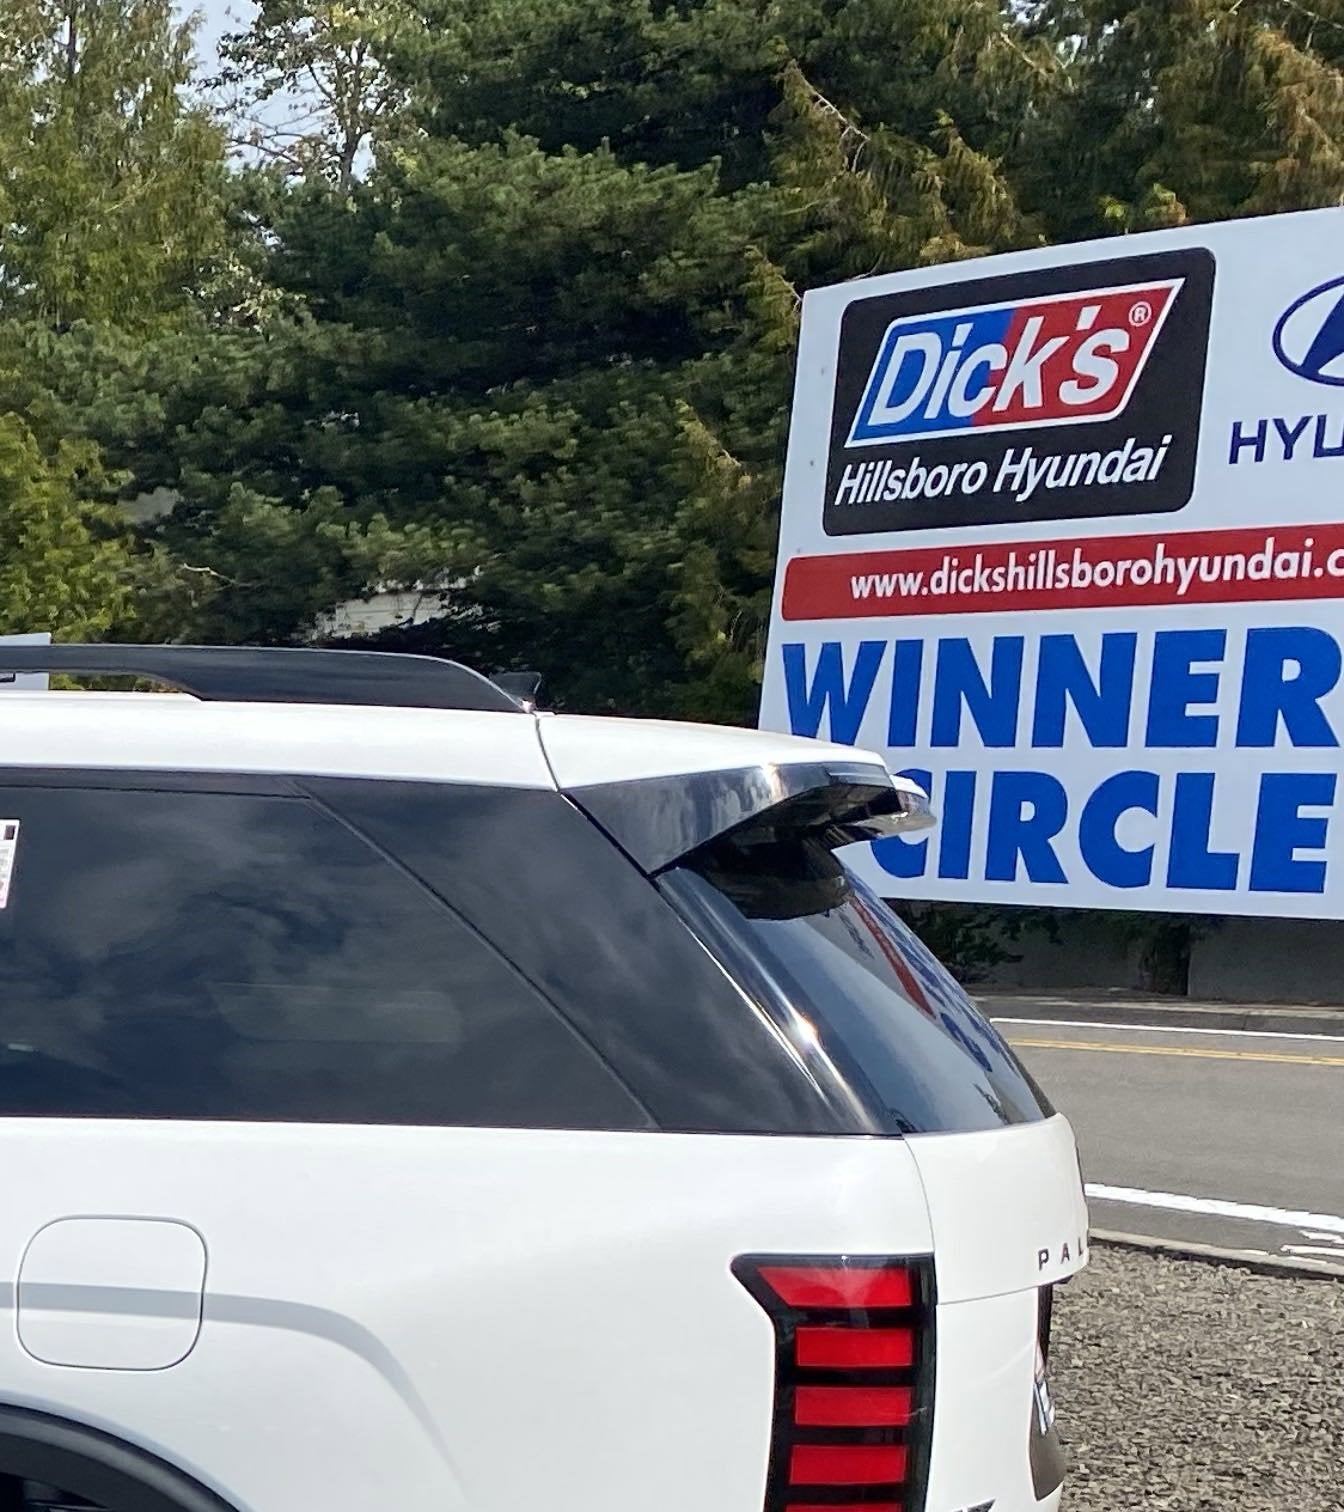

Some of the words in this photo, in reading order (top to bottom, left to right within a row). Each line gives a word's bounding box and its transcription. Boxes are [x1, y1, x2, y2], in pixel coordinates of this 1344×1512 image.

[867, 305, 1130, 427] Dick's
[835, 456, 987, 506] Hillsboro
[993, 434, 1173, 502] Hyundai
[782, 627, 1343, 747] WINNER
